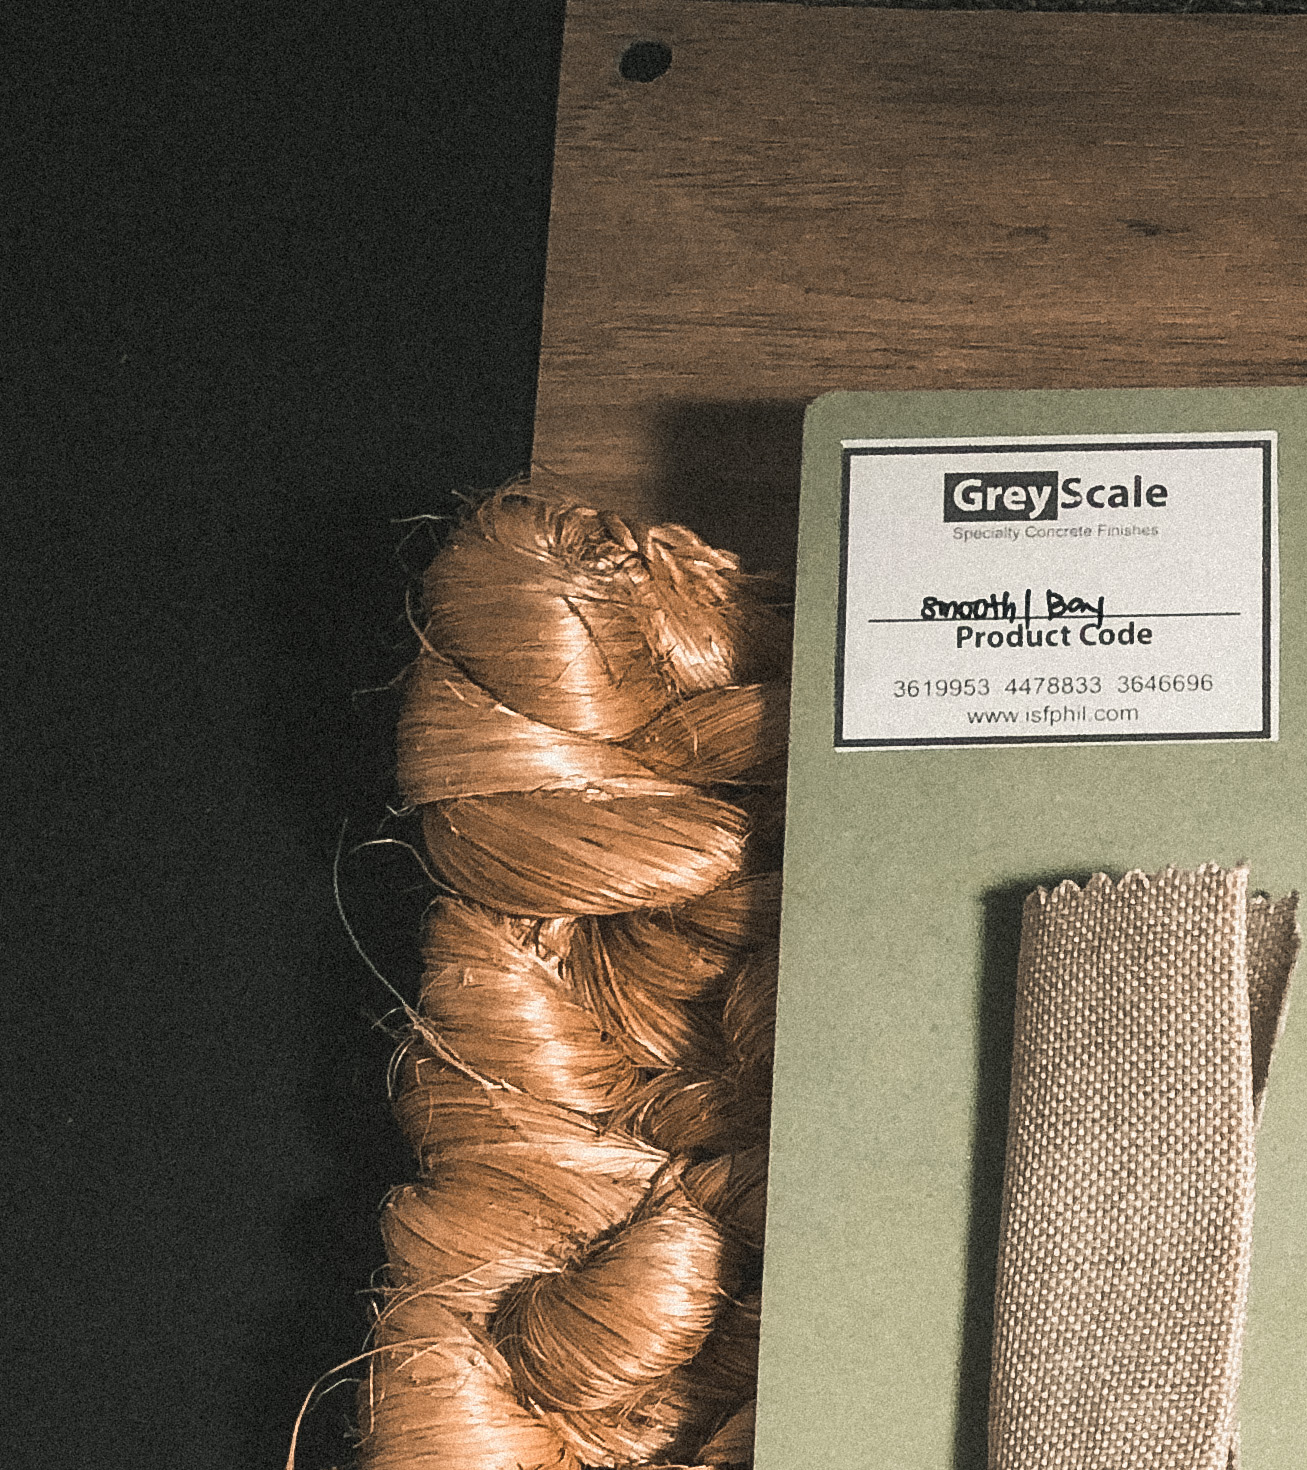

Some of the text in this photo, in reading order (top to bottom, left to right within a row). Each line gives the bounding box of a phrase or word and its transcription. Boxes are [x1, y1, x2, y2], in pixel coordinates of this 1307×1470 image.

[953, 523, 1159, 541] Specialty Concrete Finishes
[956, 621, 1154, 649] Product Code
[893, 674, 1214, 699] 3619953 4478833 3646696
